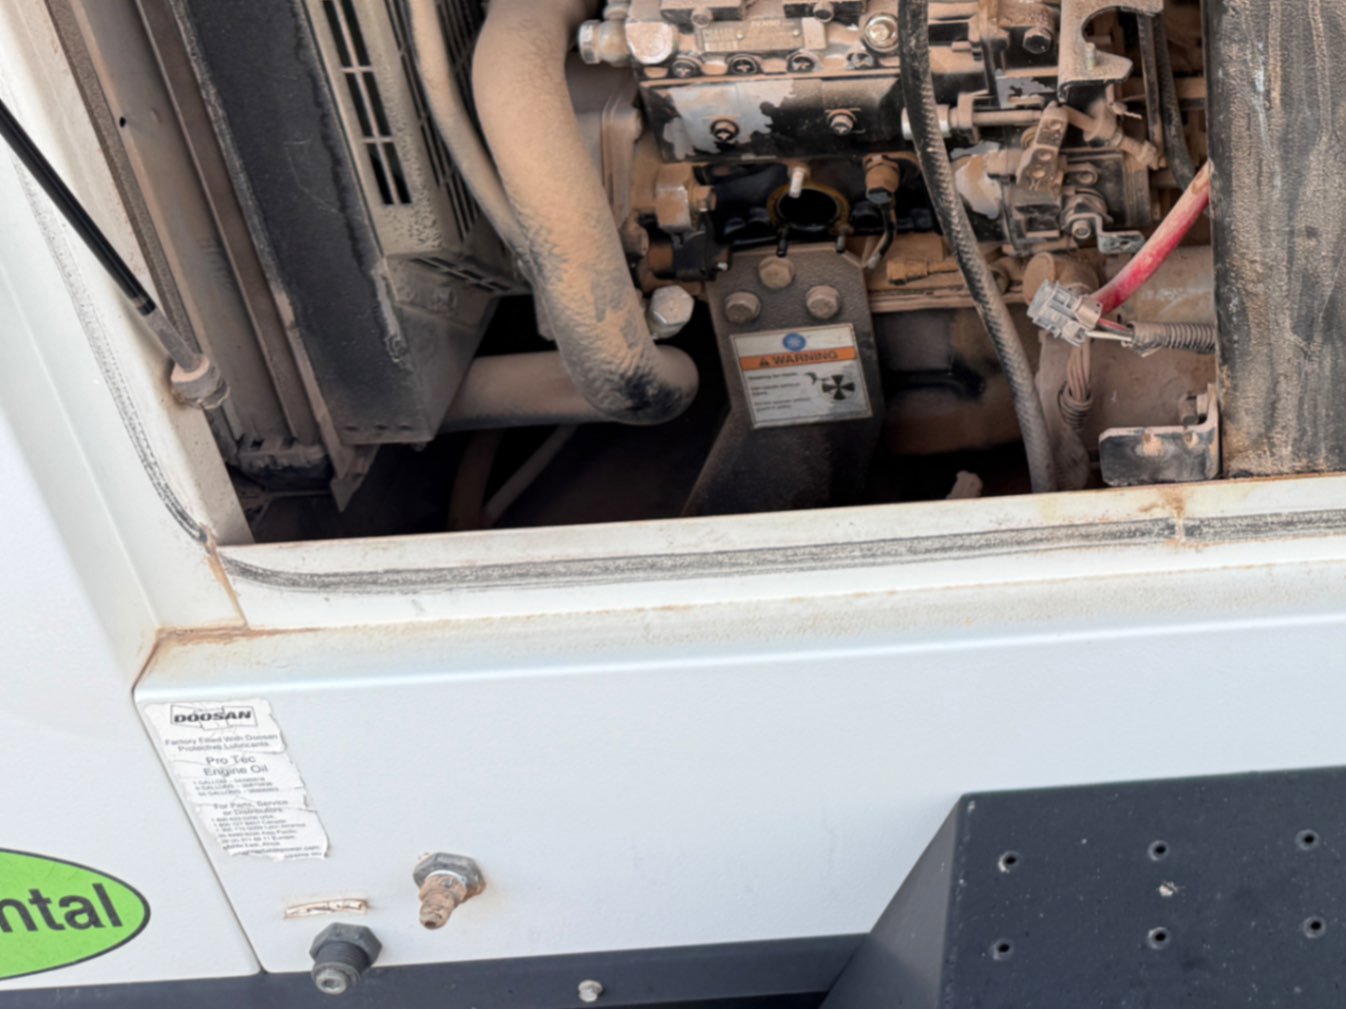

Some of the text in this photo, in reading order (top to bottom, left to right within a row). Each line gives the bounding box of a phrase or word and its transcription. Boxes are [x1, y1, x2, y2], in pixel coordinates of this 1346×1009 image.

[771, 351, 838, 366] WARNING
[174, 711, 252, 723] DOOSAN
[165, 738, 197, 747] Factory
[205, 754, 256, 765] Pro Tec
[203, 764, 268, 778] Engine Oil
